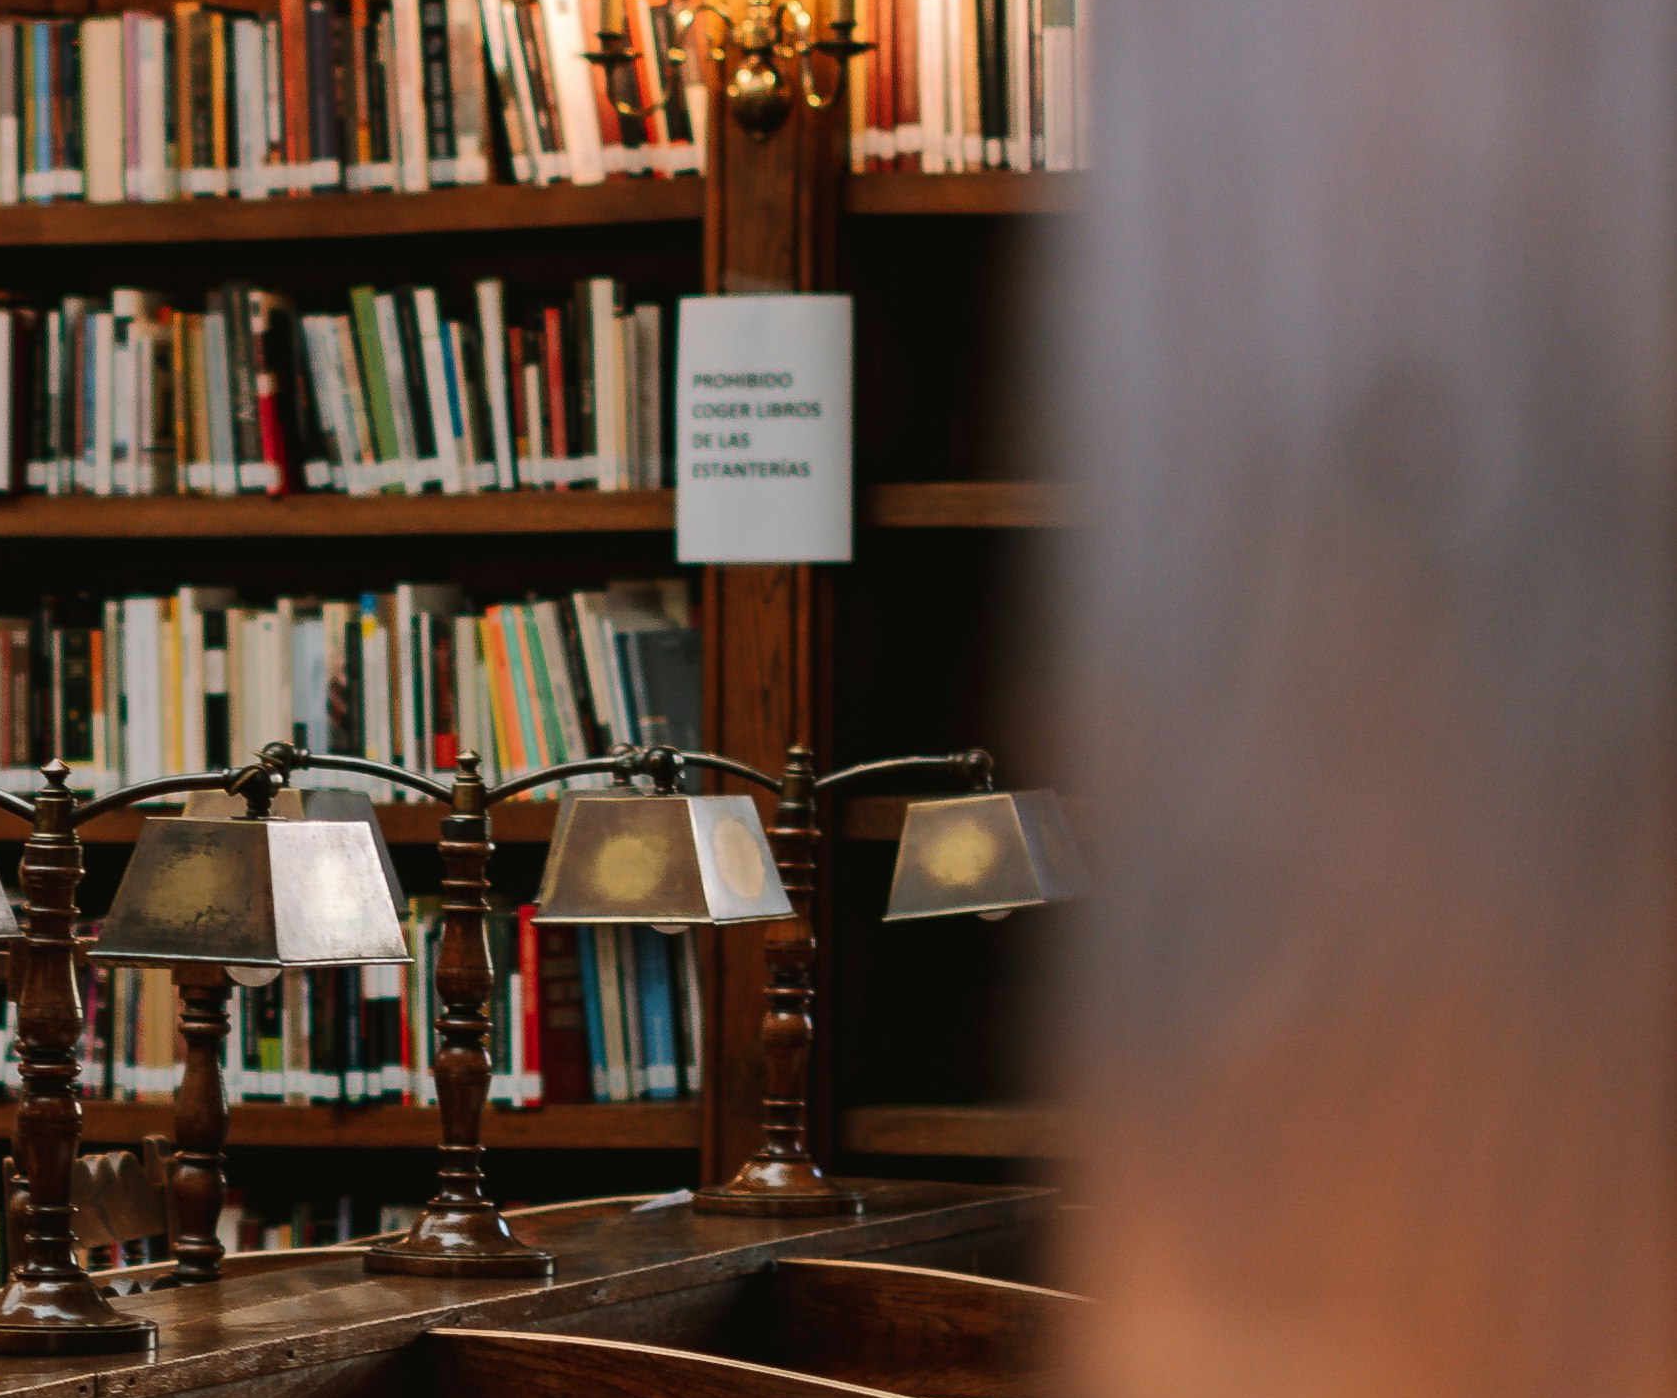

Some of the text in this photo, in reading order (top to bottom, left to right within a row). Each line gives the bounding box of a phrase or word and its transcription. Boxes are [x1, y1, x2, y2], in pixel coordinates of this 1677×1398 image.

[692, 373, 794, 389] PROHIBIDO
[692, 401, 823, 419] COGER LIBROS
[692, 432, 752, 449] DE LAS
